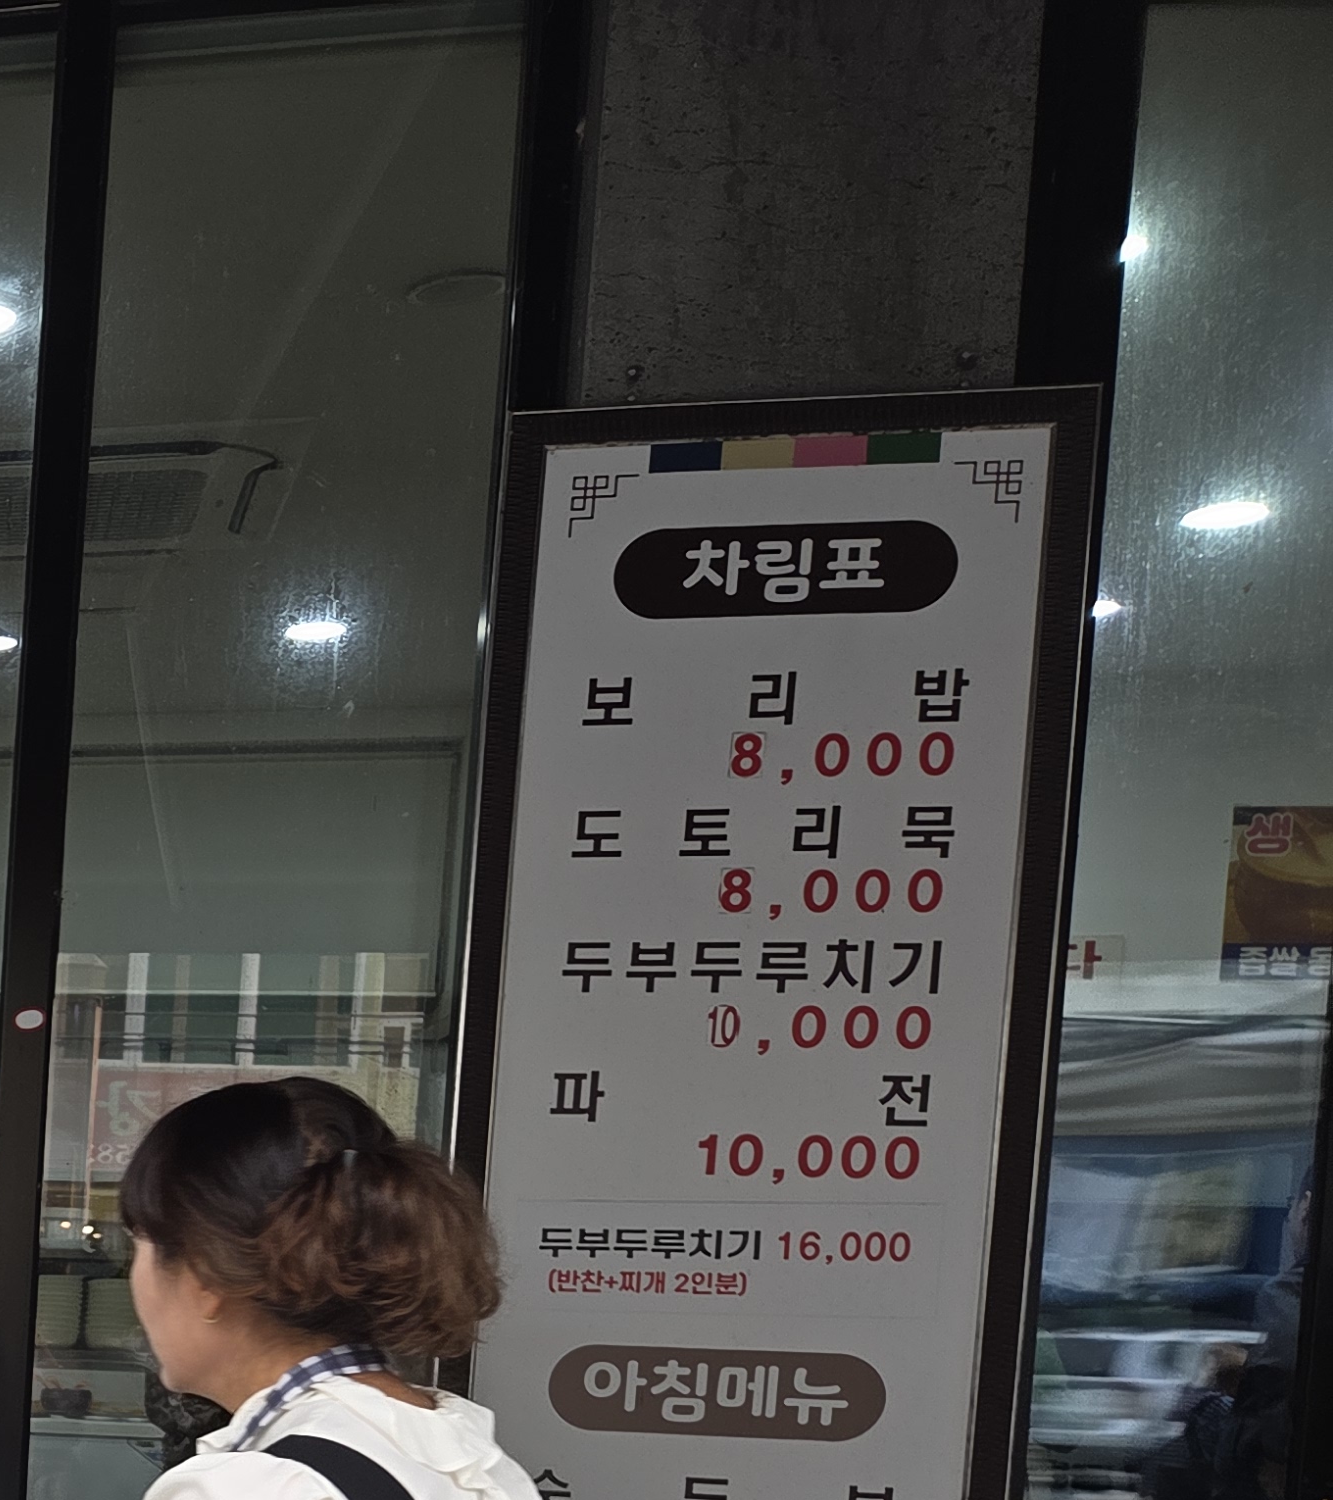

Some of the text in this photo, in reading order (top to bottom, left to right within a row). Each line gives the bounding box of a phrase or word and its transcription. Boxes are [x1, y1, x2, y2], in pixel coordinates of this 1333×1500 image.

[683, 538, 885, 603] 차림표
[731, 732, 954, 785] 8,000
[719, 869, 944, 920] 8,000
[561, 939, 944, 995] 두부두루치기
[707, 1004, 933, 1056] 10,000
[698, 1133, 920, 1184] 10,000
[538, 1226, 912, 1264] 두부두루치기 16,000
[674, 1271, 748, 1297] 2인분)
[583, 1359, 849, 1427] 아침메뉴
